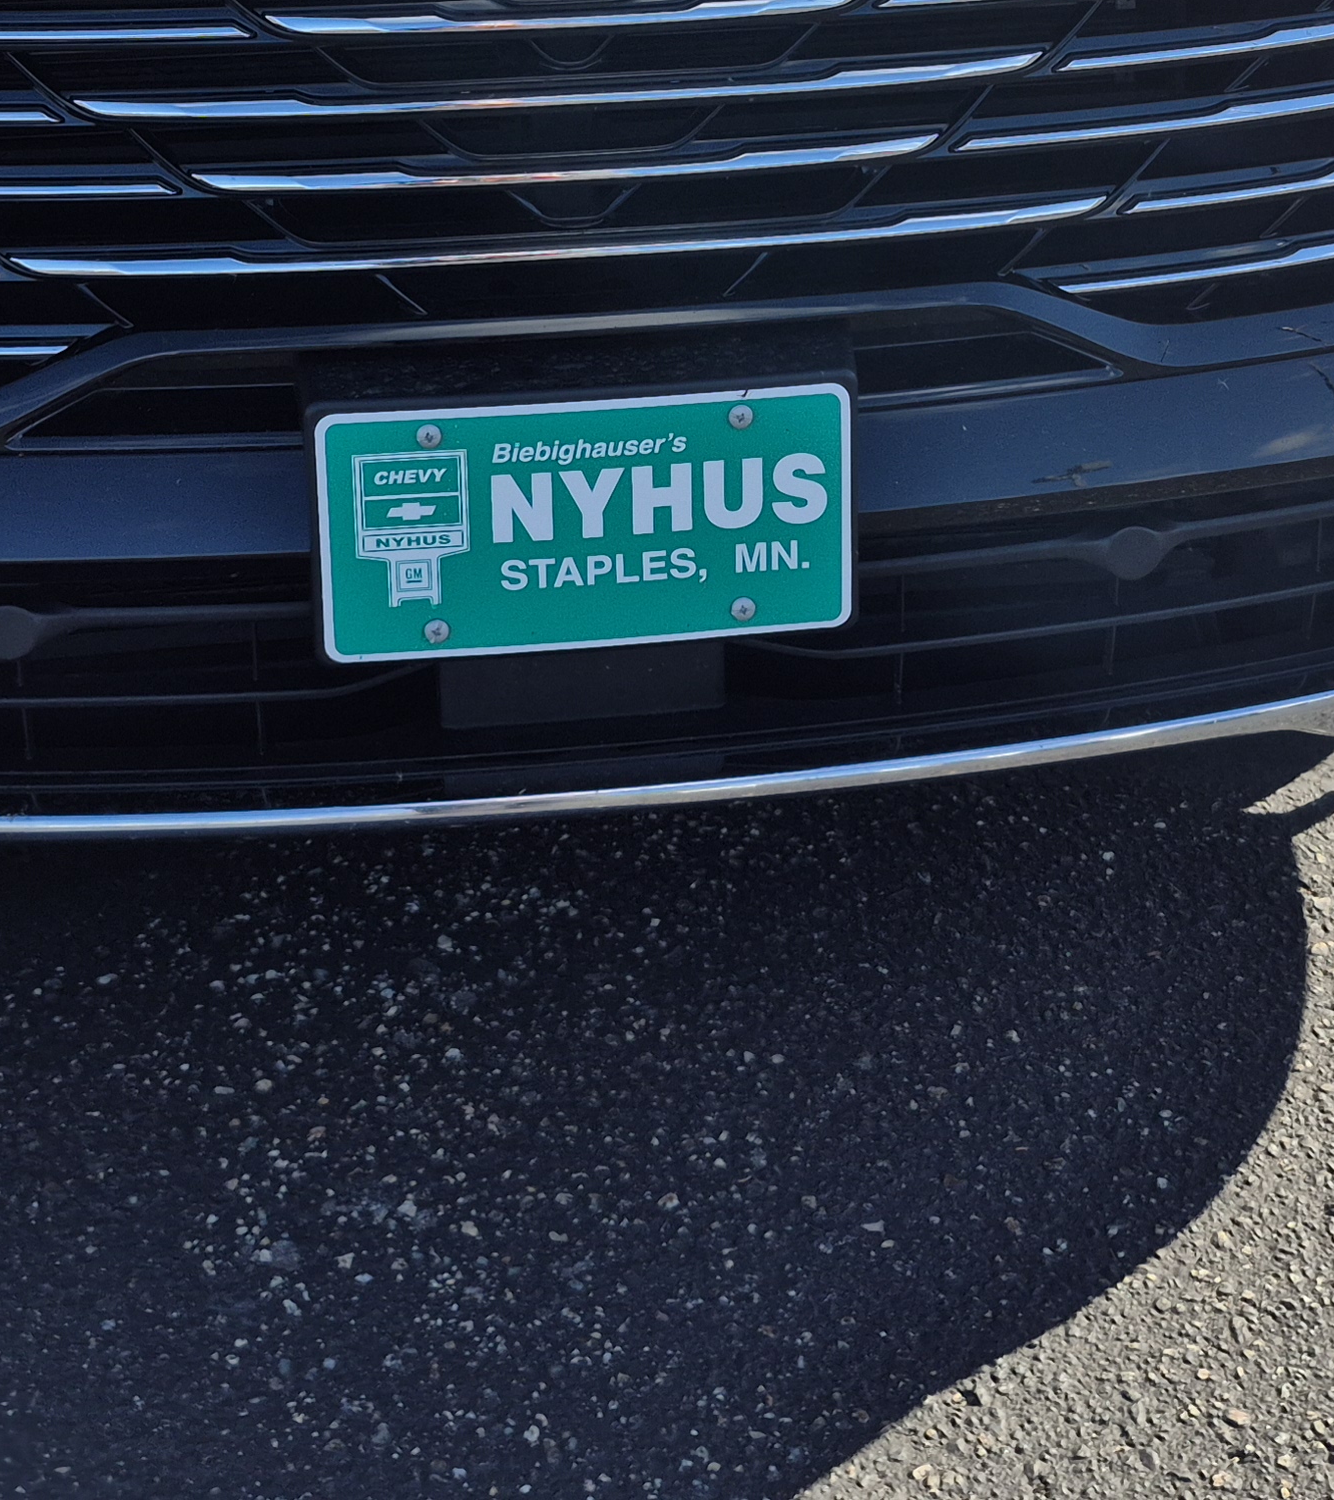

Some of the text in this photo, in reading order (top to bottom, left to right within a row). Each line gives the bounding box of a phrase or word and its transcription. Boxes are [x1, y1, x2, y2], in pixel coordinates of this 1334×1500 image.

[492, 432, 687, 466] Biebighauser's
[374, 468, 447, 486] CHEVY
[490, 452, 829, 544] NYHUS
[376, 534, 452, 549] NYHUS
[405, 567, 423, 580] GM
[500, 540, 810, 591] STAPLES, MN.
